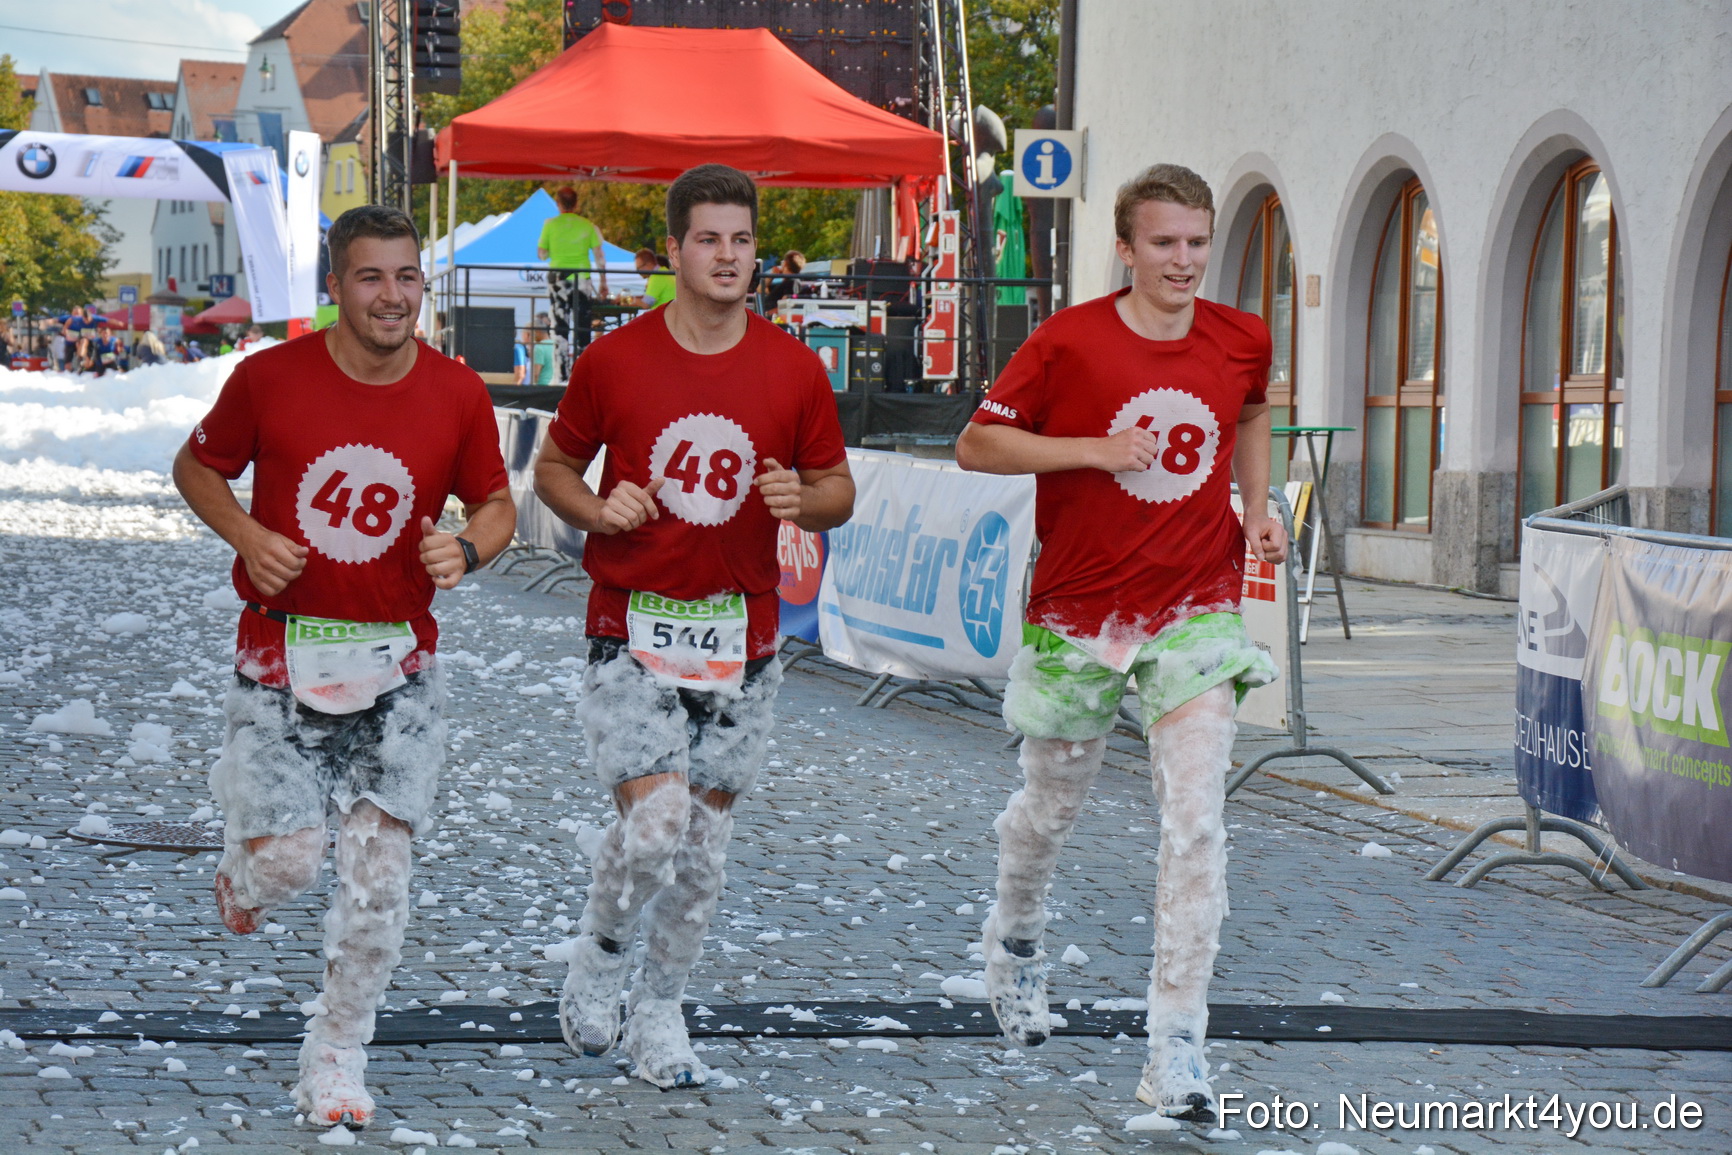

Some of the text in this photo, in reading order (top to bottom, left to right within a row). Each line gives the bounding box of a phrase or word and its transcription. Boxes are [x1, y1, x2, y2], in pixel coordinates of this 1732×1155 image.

[980, 399, 1018, 419] OMAS
[777, 524, 819, 582] ervis
[296, 620, 396, 643] BOC
[652, 621, 720, 655] 544
[1599, 633, 1722, 732] BOCK
[1671, 753, 1732, 791] concepts
